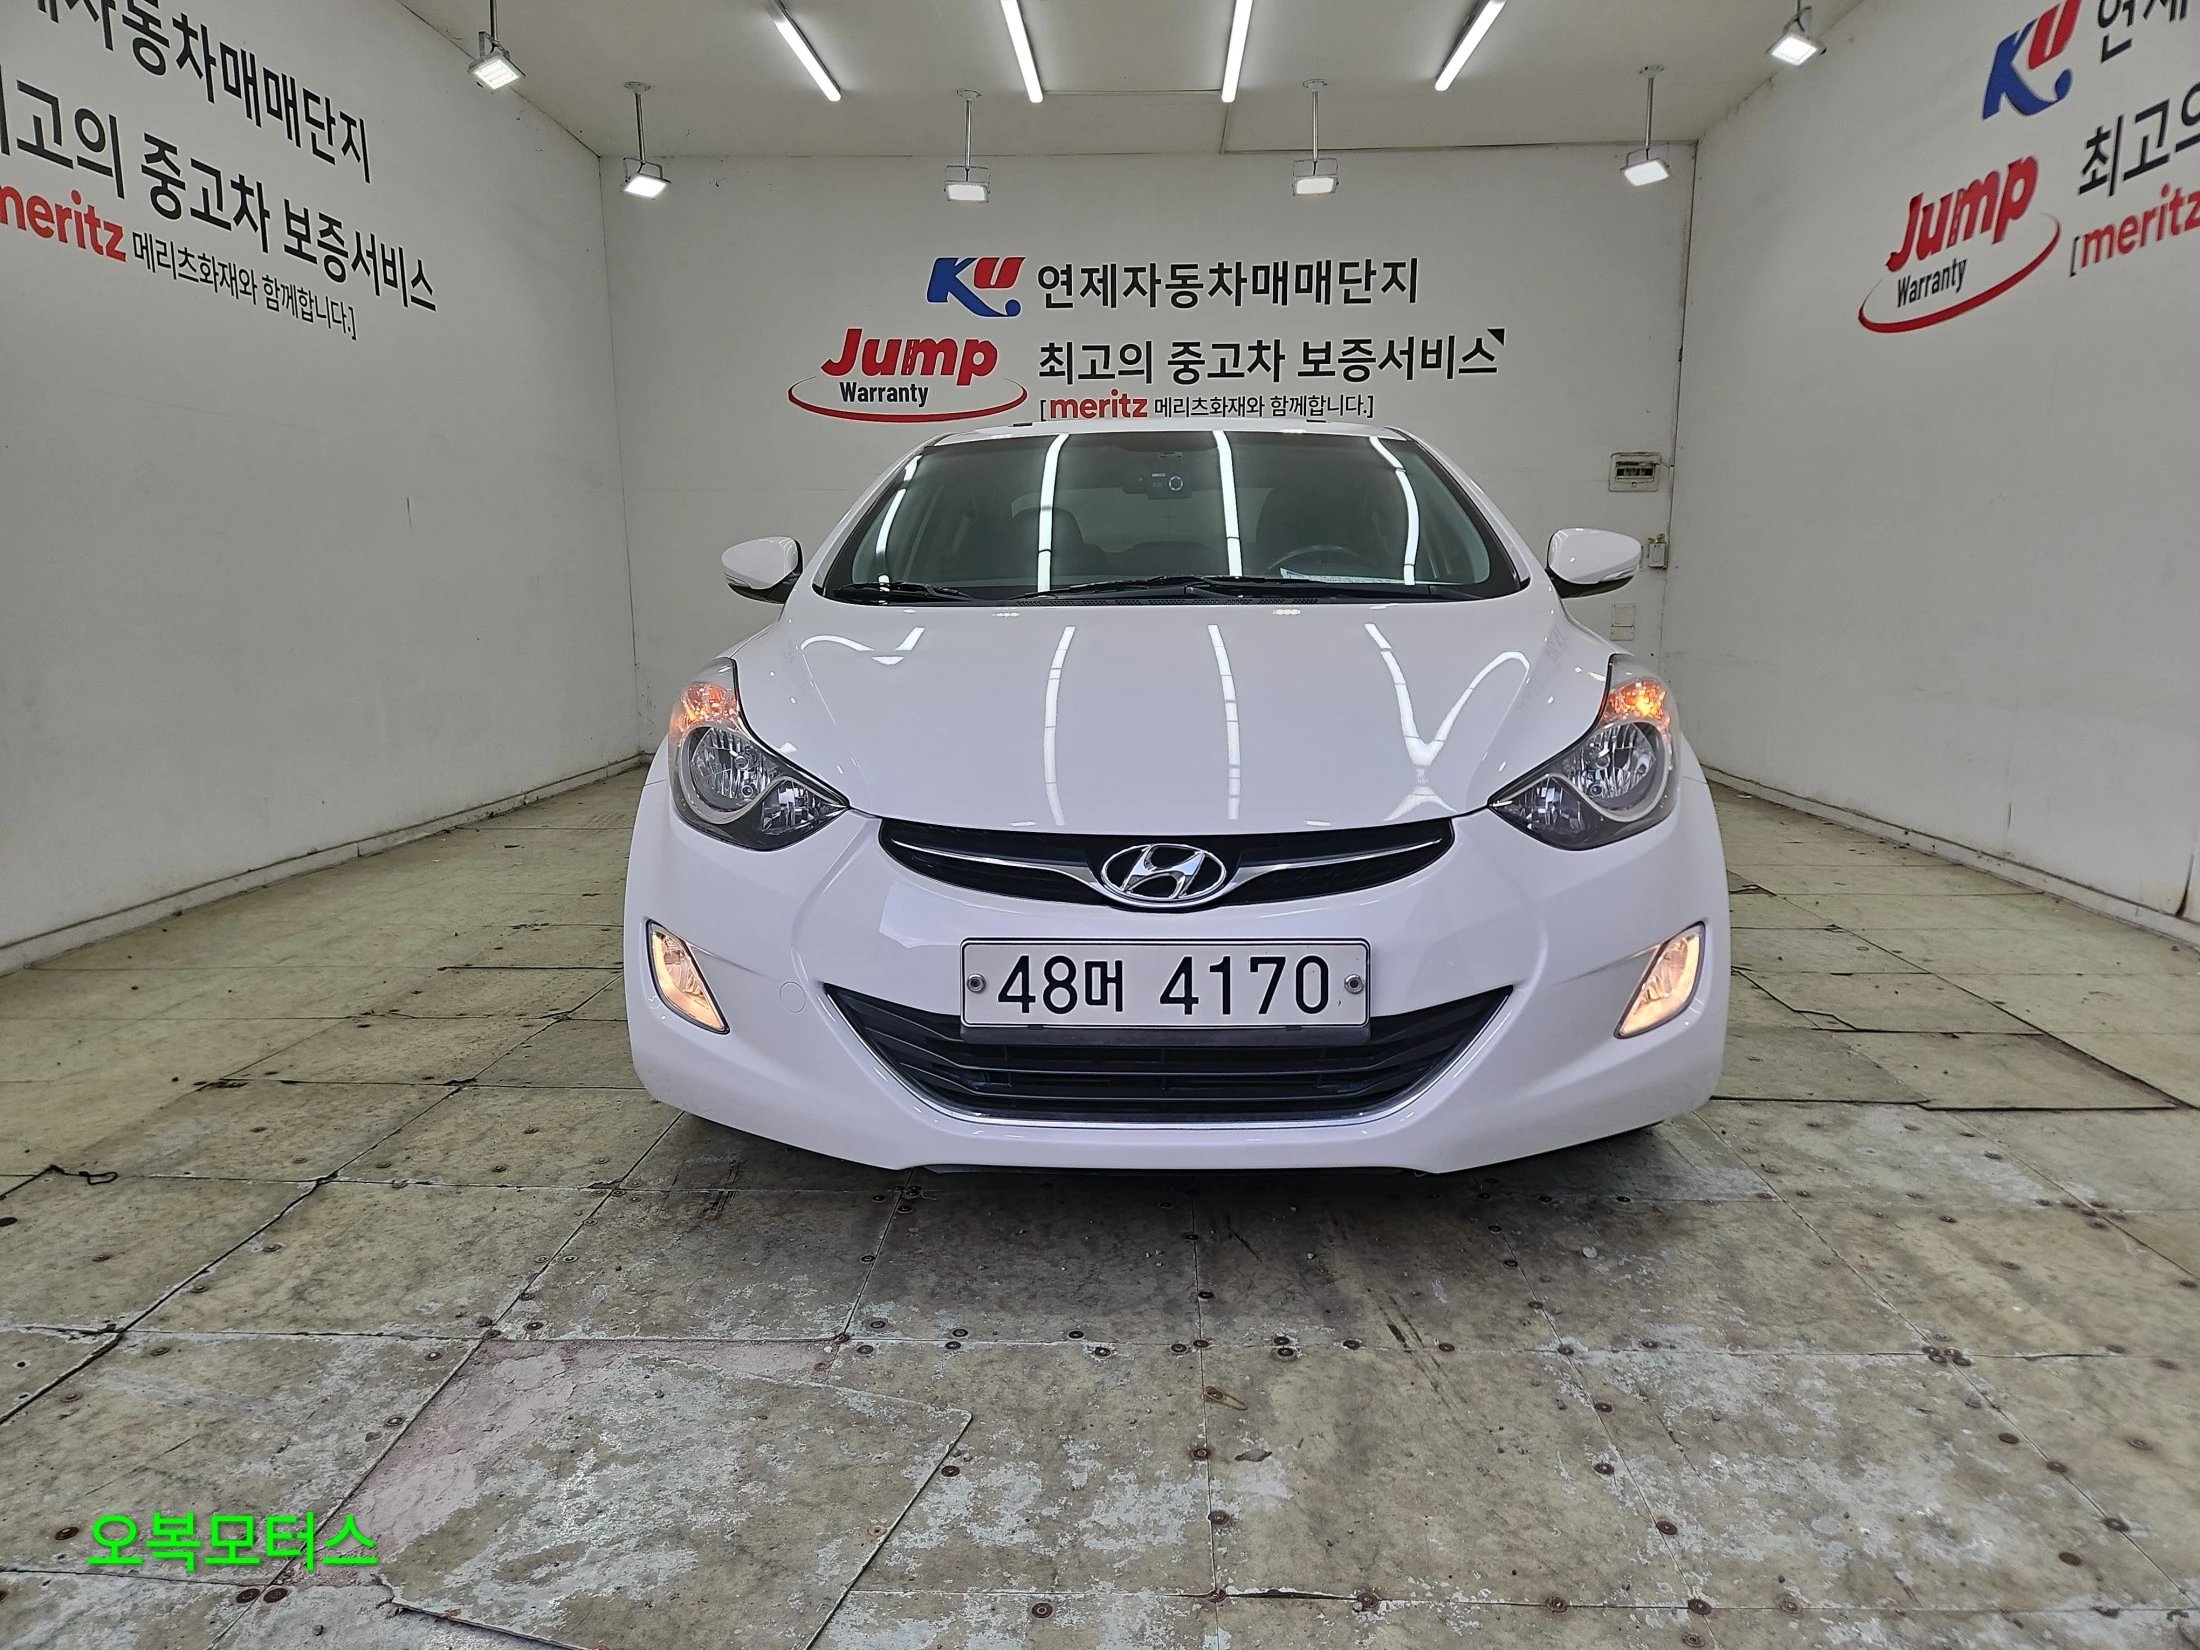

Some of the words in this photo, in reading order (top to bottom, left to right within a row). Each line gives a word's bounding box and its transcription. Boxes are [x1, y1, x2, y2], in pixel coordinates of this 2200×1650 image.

[0, 63, 125, 200] 고의
[141, 132, 271, 255] 중고차
[283, 198, 437, 312] 보증서비스
[1885, 155, 2039, 273] Jump
[132, 231, 258, 306] 메리츠화재와
[929, 257, 1025, 319] KU
[1038, 258, 1419, 310] 연제자동차매매단지
[1897, 257, 1968, 308] Warranty
[823, 329, 999, 388] Jump
[1040, 341, 1153, 386] 최고의
[1168, 340, 1287, 386] 중고차
[1297, 335, 1498, 383] 보증서비스
[840, 382, 930, 409] Warranty
[1155, 396, 1266, 419] 메리츠화재와
[998, 956, 1124, 1016] 48머
[1160, 956, 1330, 1016] 4170
